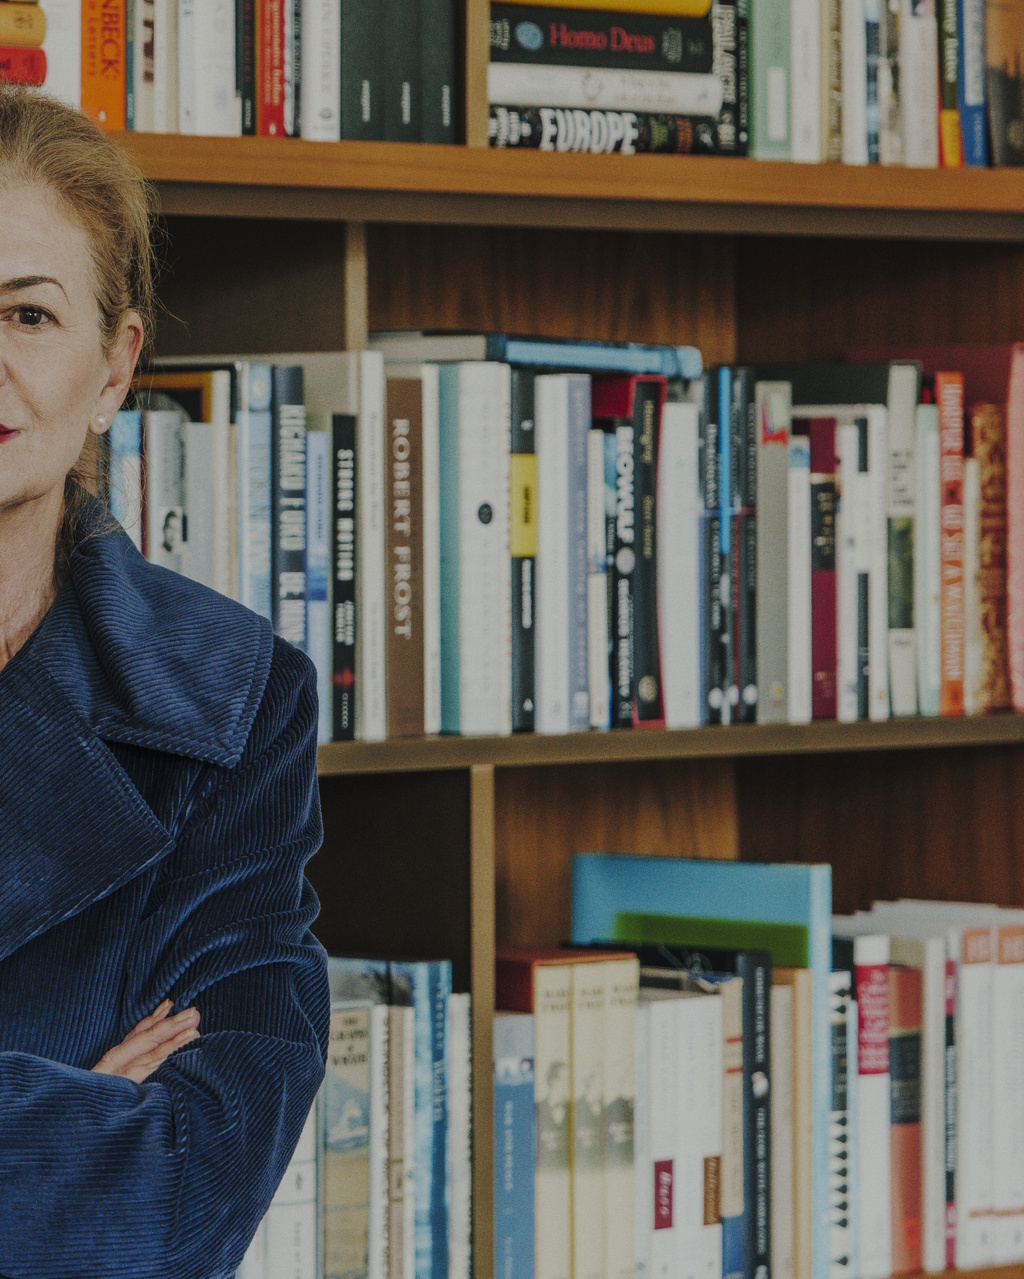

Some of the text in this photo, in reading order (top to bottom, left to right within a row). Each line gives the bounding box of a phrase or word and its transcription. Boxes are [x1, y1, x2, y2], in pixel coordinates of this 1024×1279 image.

[549, 23, 656, 53] Homo Deus
[540, 109, 638, 155] EUROPE
[393, 418, 411, 639] ROBERT FROST
